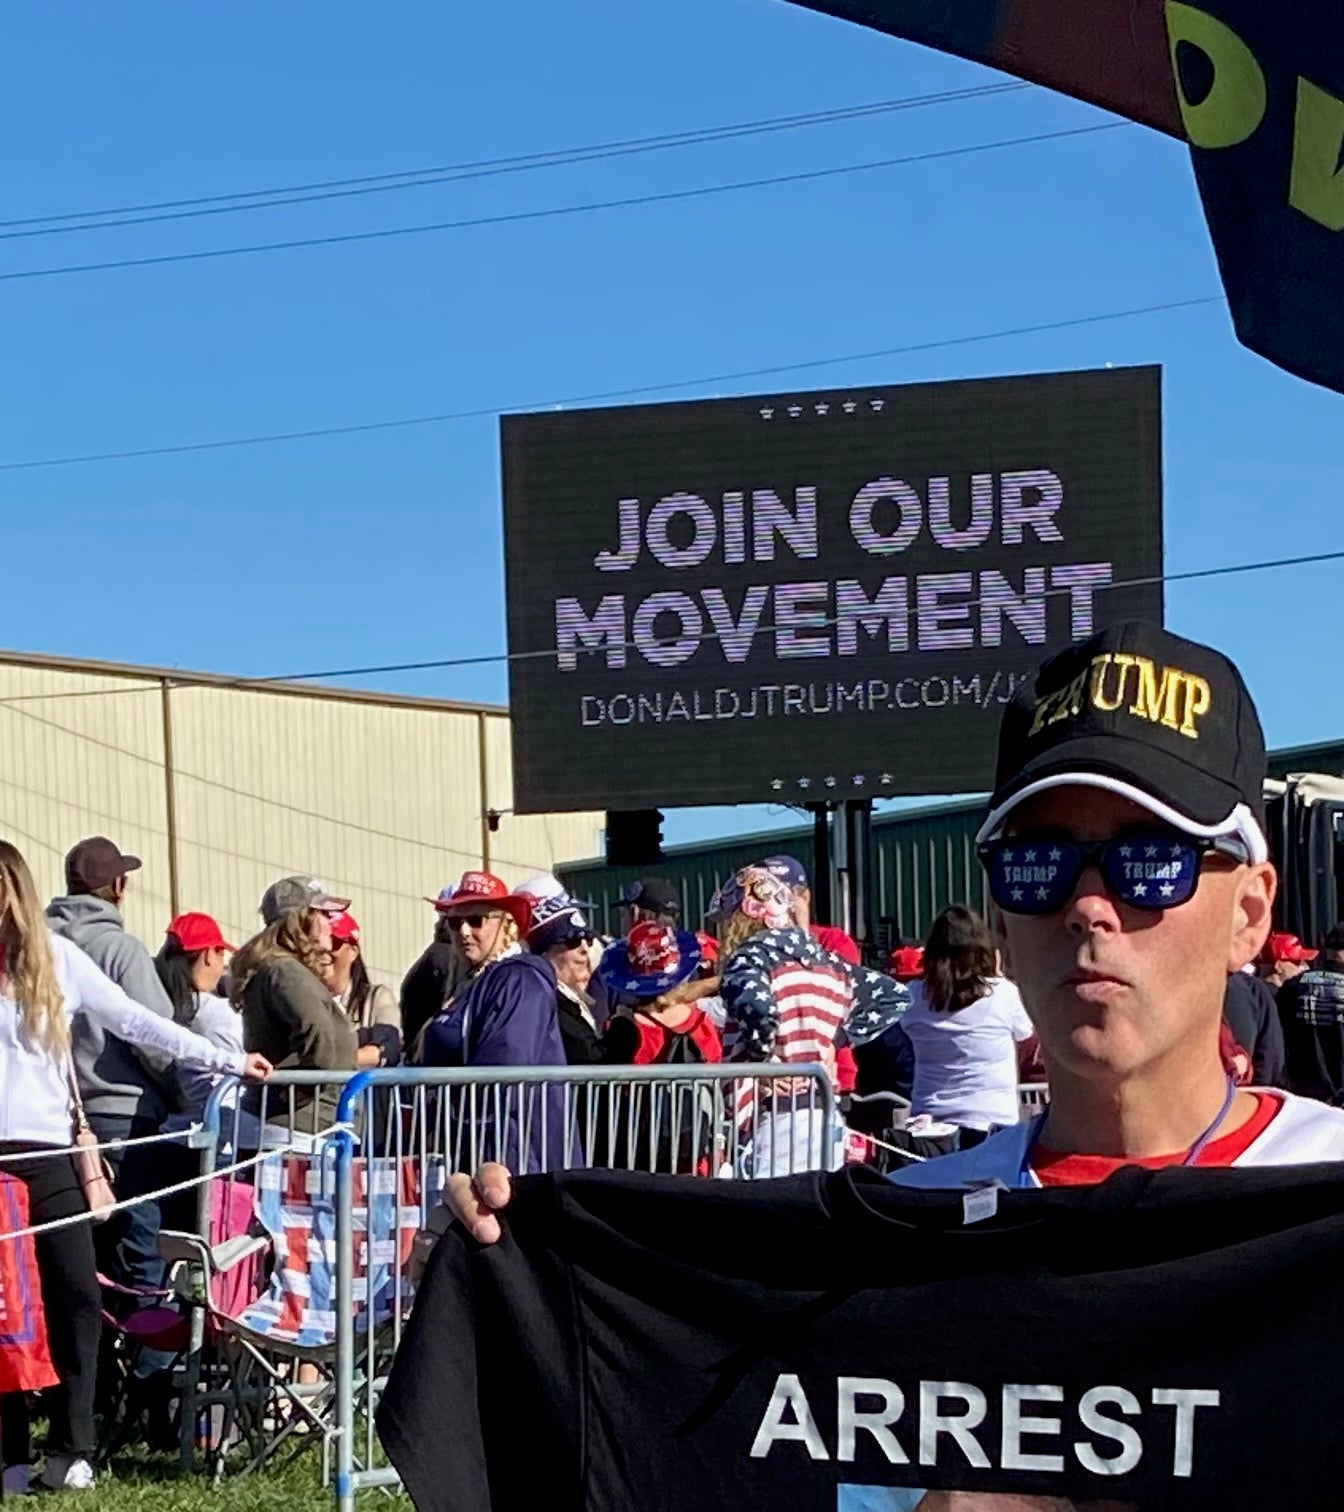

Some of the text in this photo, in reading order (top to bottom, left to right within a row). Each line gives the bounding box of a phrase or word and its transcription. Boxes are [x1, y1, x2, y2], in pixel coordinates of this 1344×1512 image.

[594, 469, 1065, 573] JOIN OUR
[556, 562, 1113, 671] MOVEMENT
[581, 668, 1029, 727] DONALDJTRUMP.COM/J
[1028, 653, 1211, 739] TRUMP
[1003, 865, 1058, 883] TRUMP
[1123, 861, 1182, 880] TRUMP
[749, 1373, 1221, 1478] ARREST
